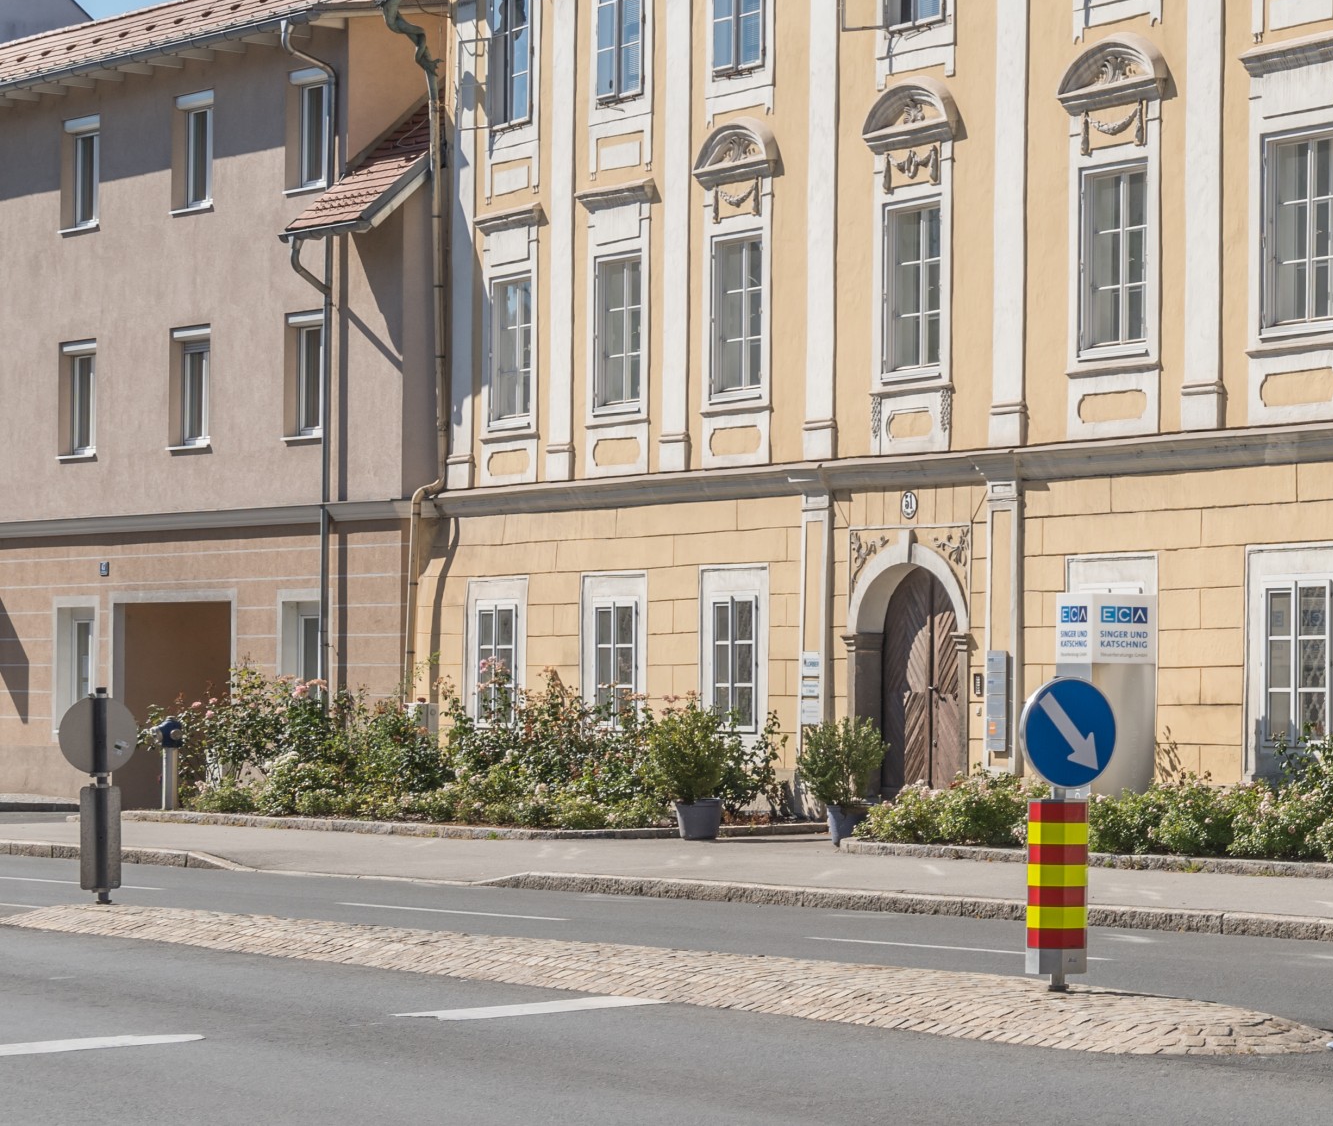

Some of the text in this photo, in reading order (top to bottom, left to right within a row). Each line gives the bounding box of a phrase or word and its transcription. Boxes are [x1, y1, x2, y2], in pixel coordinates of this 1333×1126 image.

[1062, 608, 1087, 622] ECA
[1102, 608, 1146, 622] ECA
[1100, 630, 1128, 638] SINGER
[1100, 640, 1148, 648] KATSCHNIG
